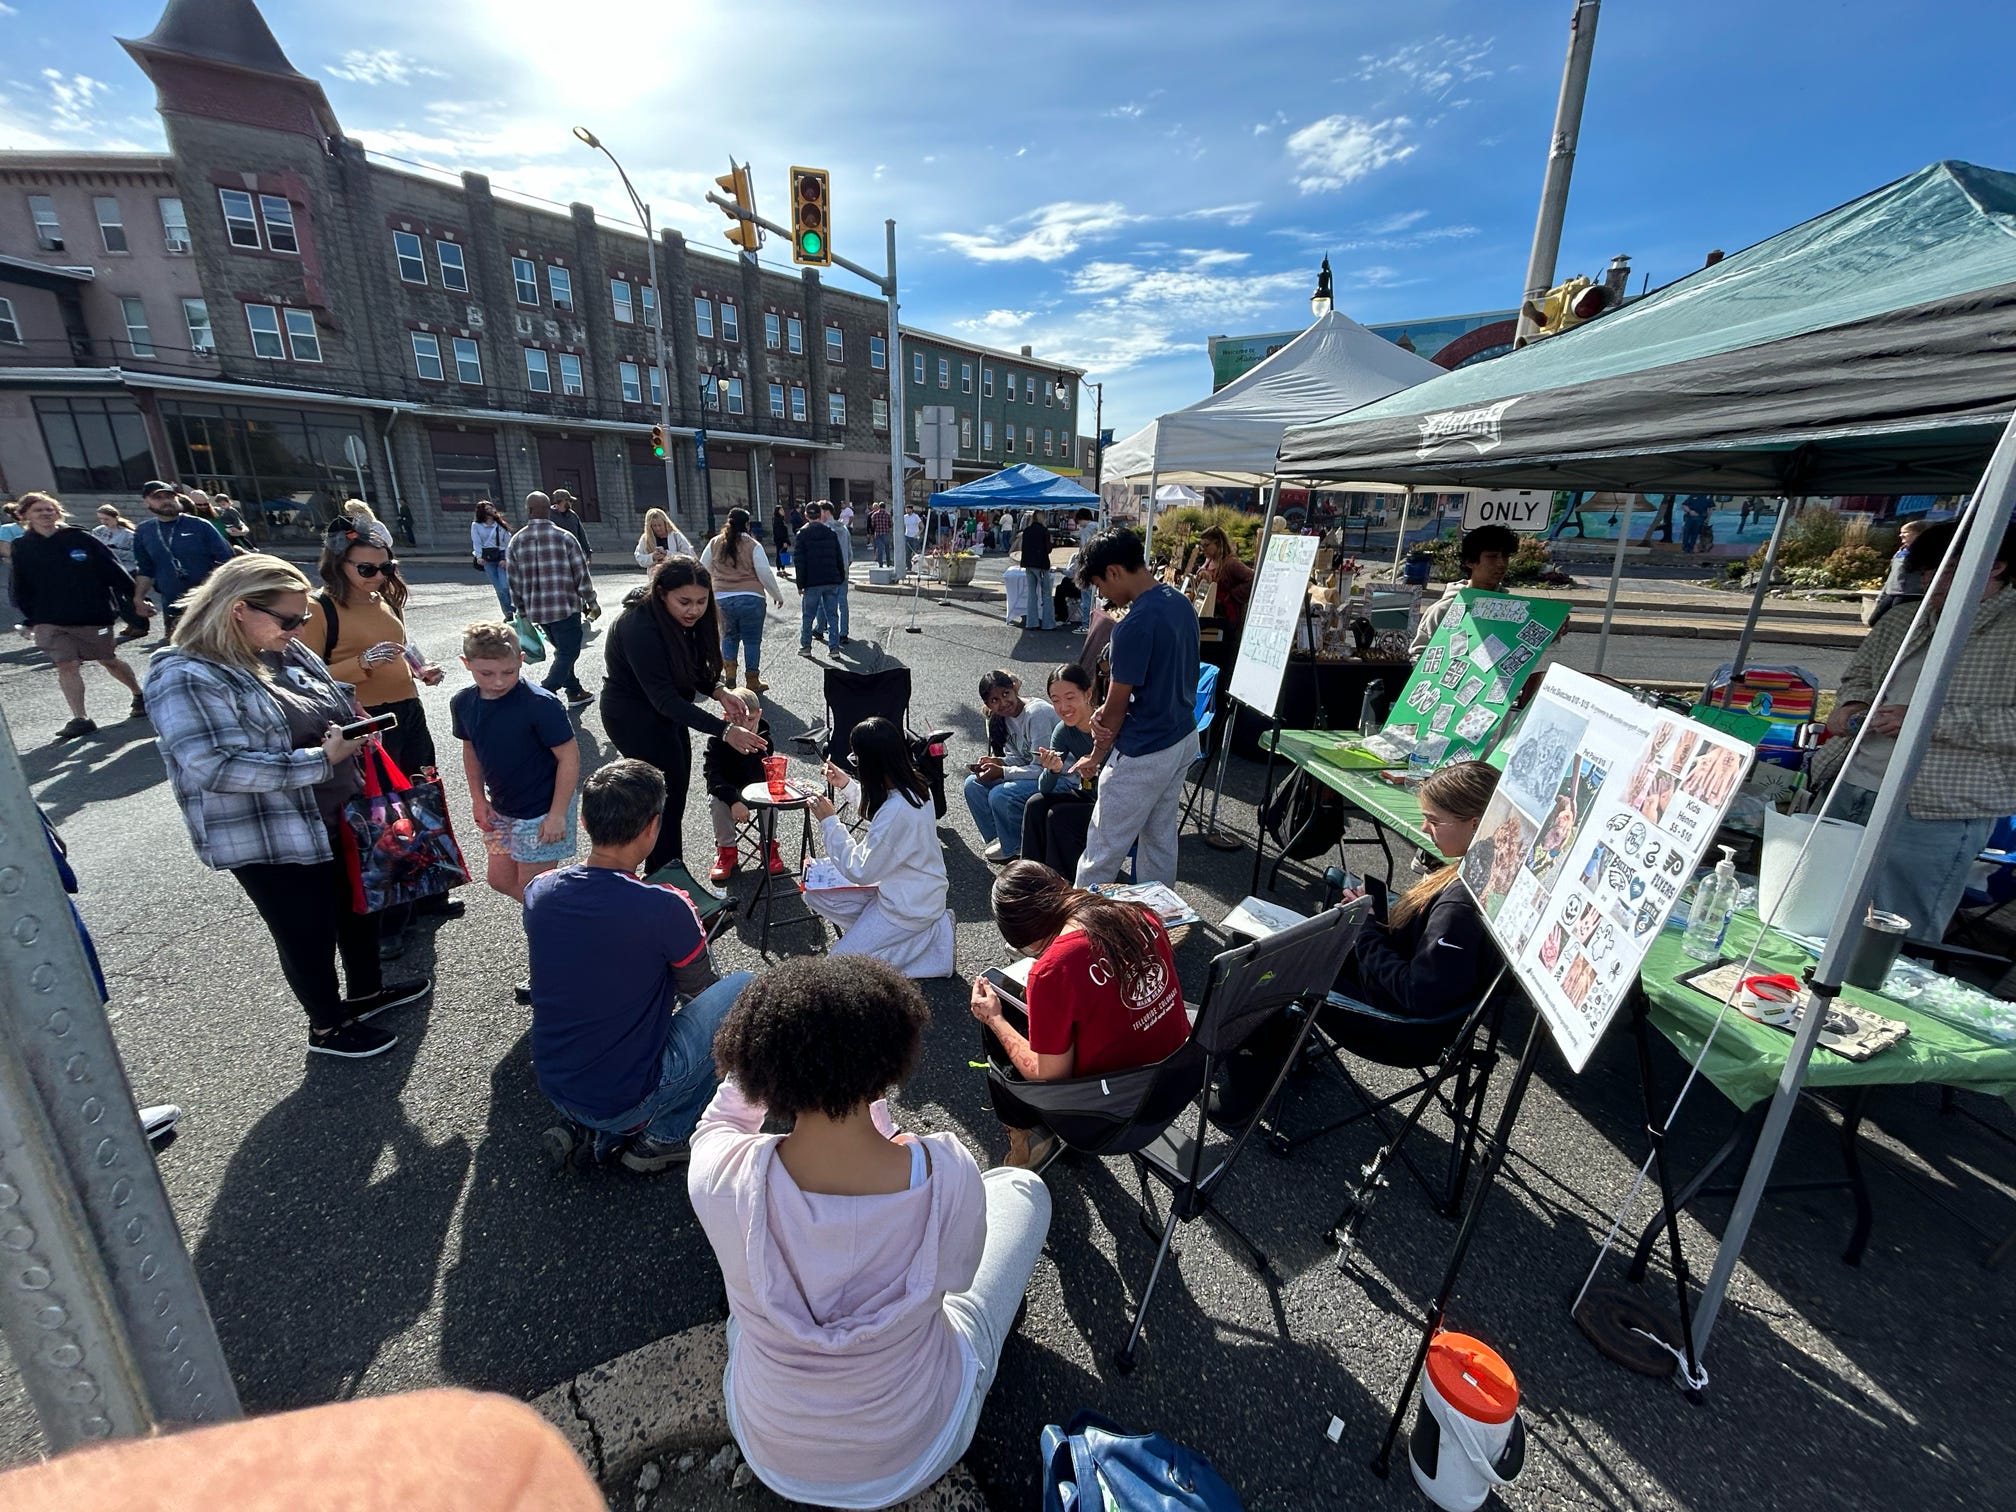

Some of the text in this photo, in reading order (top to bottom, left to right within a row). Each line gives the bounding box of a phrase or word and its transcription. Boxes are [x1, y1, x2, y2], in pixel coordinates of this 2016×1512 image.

[467, 306, 586, 343] BUSH
[1480, 502, 1539, 521] ONLY
[1677, 811, 1697, 827] Henna
[1686, 799, 1701, 815] Kids
[1669, 822, 1678, 834] $5
[1680, 829, 1692, 843] $10
[1610, 854, 1636, 884] EAGLES
[1651, 873, 1675, 899] FLYERS
[1136, 981, 1165, 1007] WARM HEART
[1132, 988, 1178, 1031] TELLURIDE COLORADO
